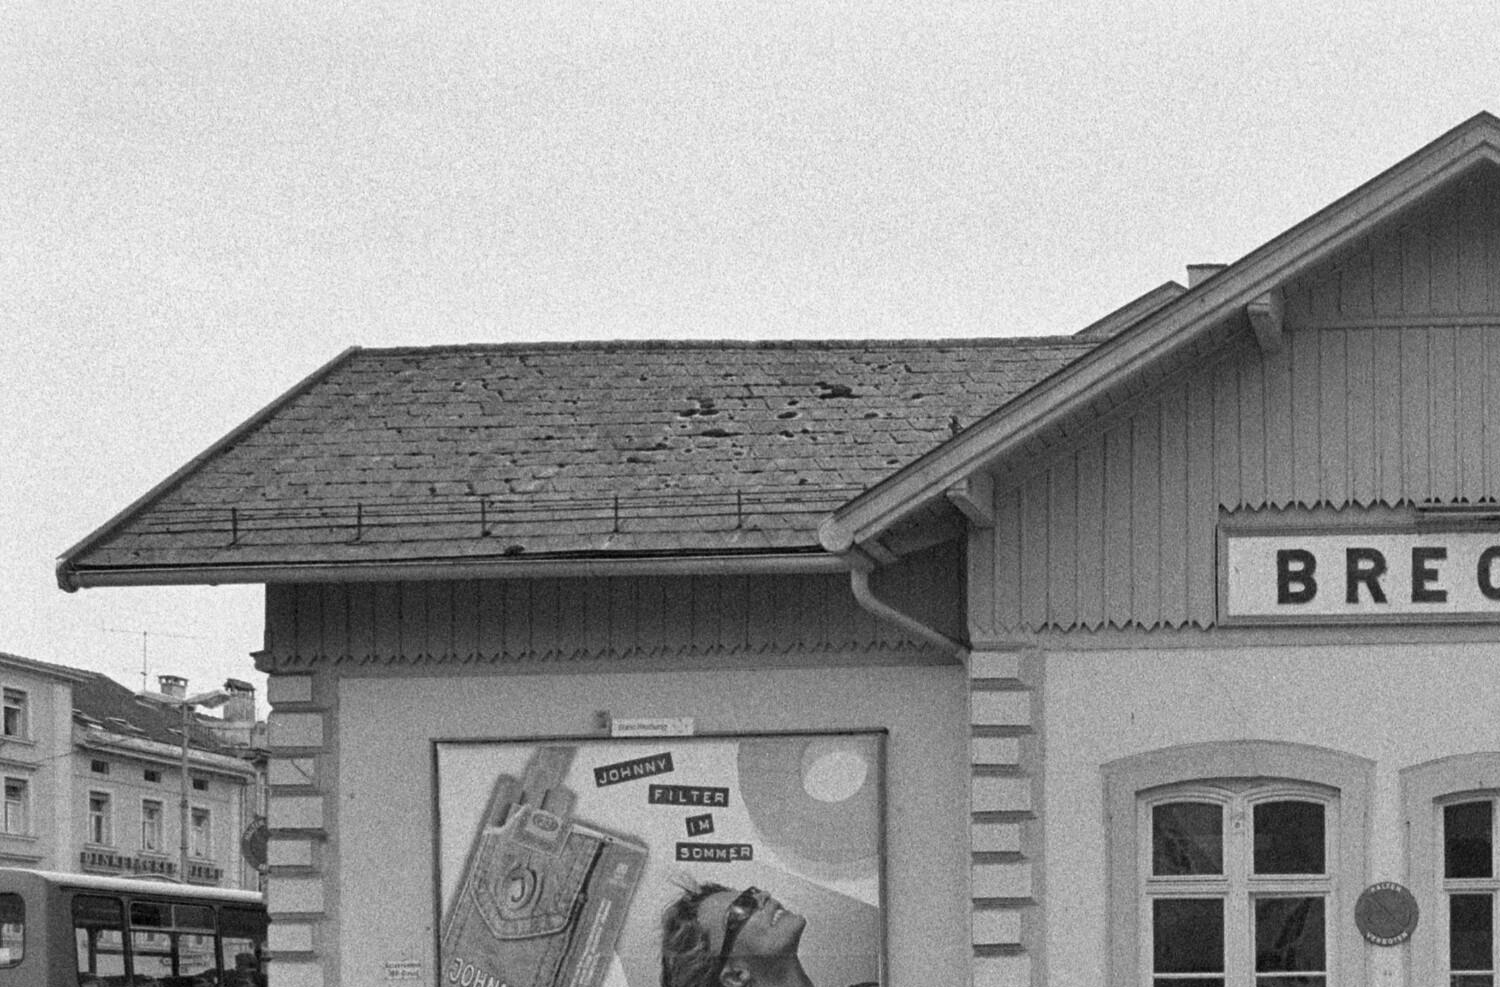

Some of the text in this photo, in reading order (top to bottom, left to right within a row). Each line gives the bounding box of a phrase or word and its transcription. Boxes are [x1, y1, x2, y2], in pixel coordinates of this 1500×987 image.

[599, 758, 667, 784] JOHNNY
[654, 789, 724, 803] FILTER
[689, 819, 710, 833] IM
[680, 846, 750, 858] SOMMER
